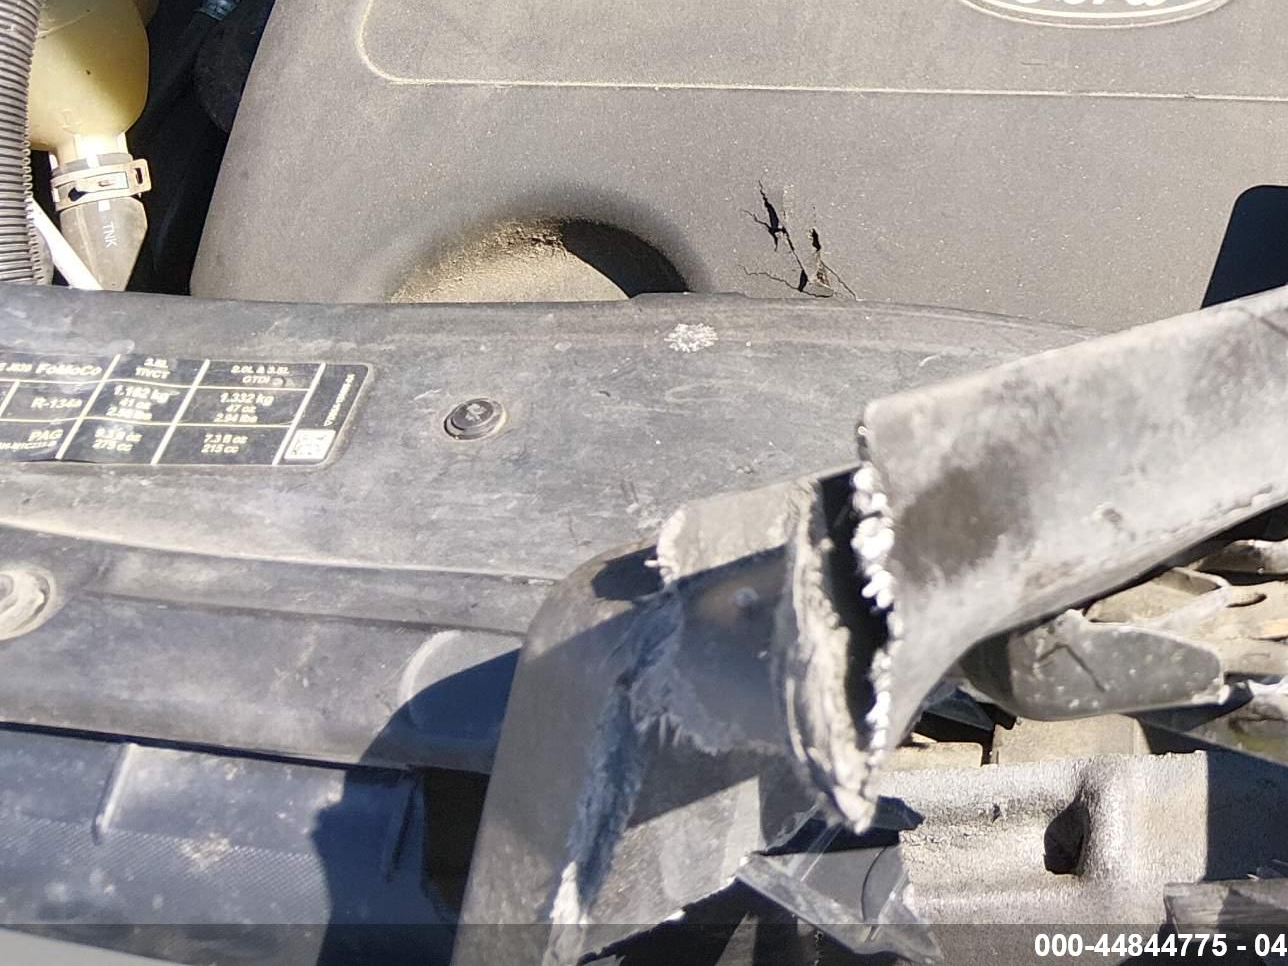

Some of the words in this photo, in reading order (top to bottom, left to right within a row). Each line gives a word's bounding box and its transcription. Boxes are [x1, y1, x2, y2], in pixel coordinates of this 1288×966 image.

[35, 362, 103, 376] FoMoCo
[30, 396, 83, 409] R-134a
[151, 388, 171, 404] kg
[256, 393, 275, 407] kg
[28, 429, 64, 442] PAG
[201, 443, 225, 454] 215
[223, 445, 240, 454] cc
